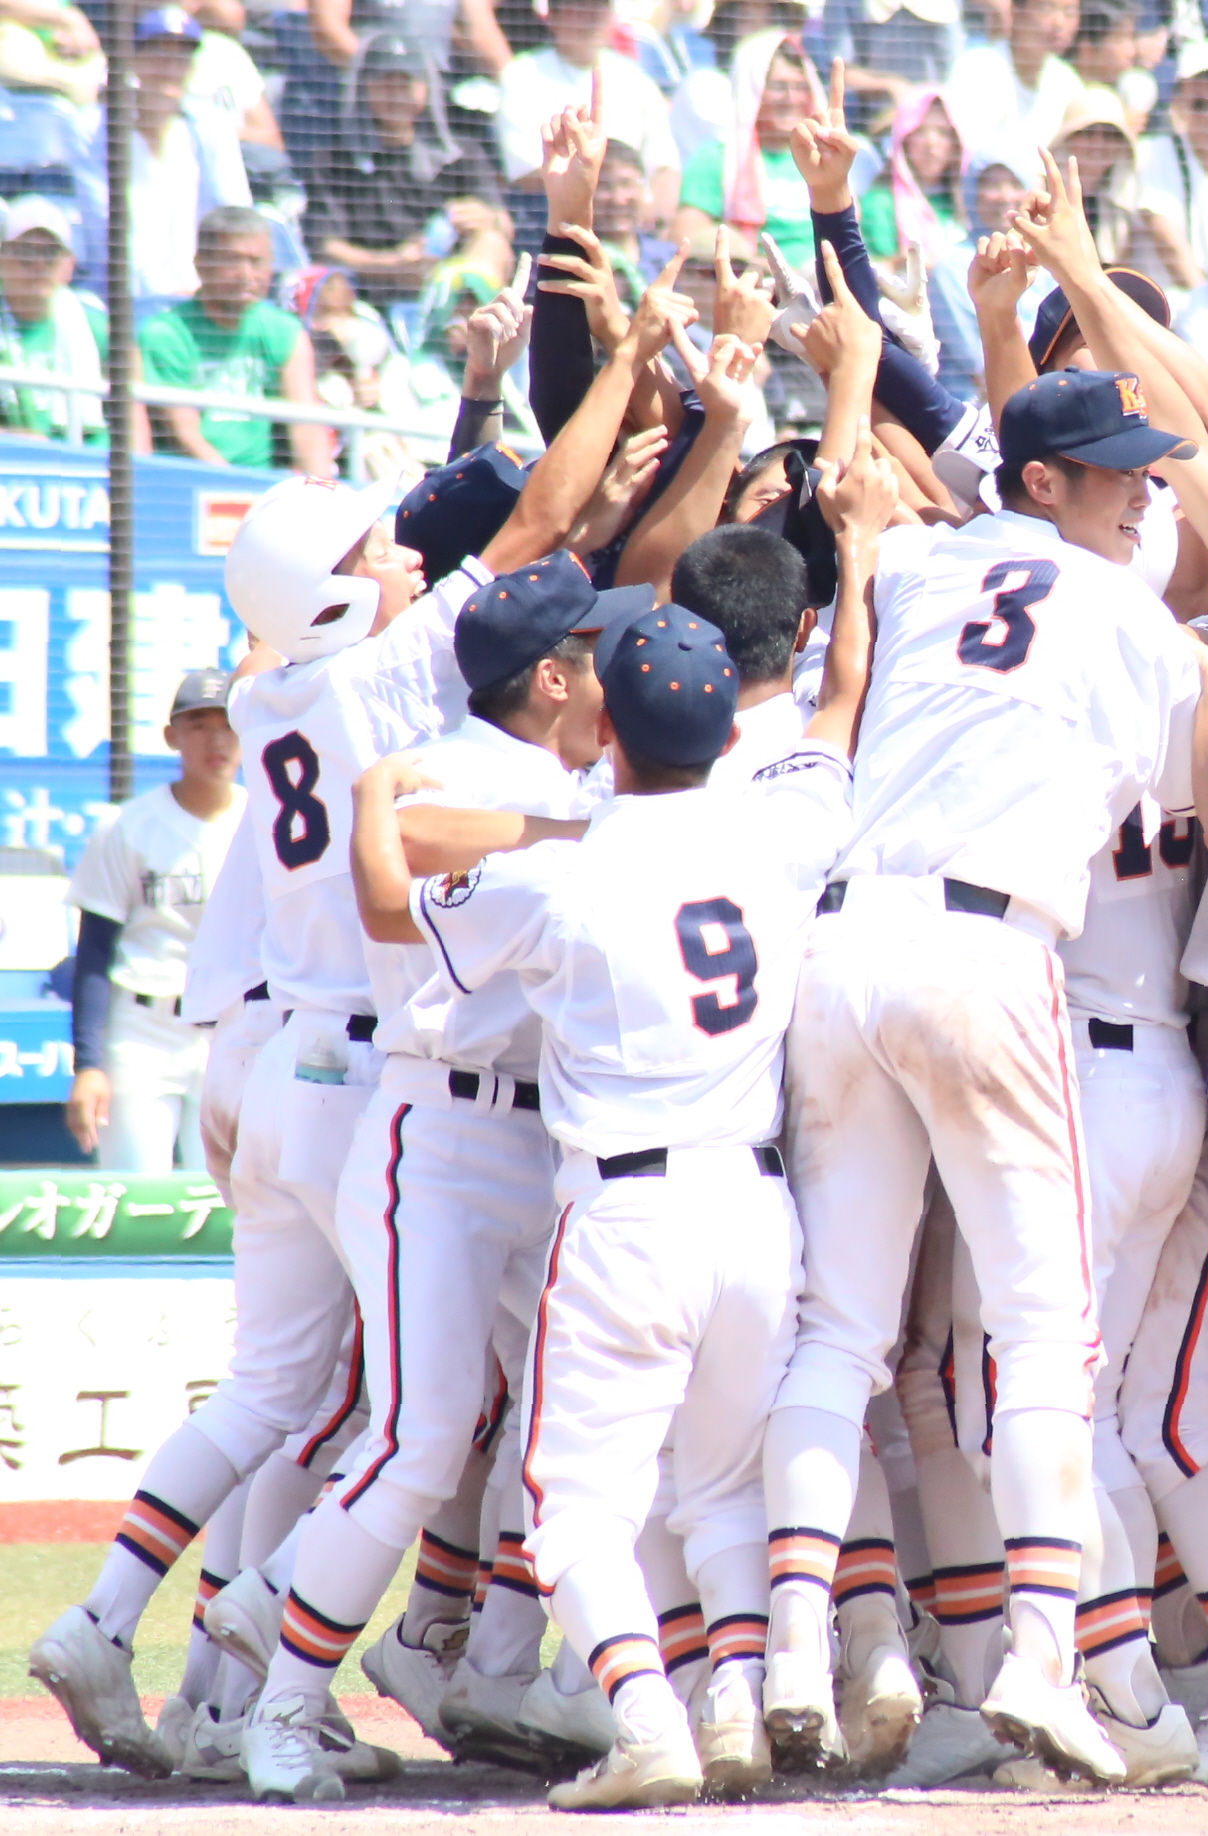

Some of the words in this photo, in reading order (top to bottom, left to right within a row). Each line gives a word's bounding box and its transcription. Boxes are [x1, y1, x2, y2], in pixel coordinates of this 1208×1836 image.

[955, 558, 1061, 675] 3
[262, 730, 331, 872] 8
[673, 896, 760, 1038] 9
